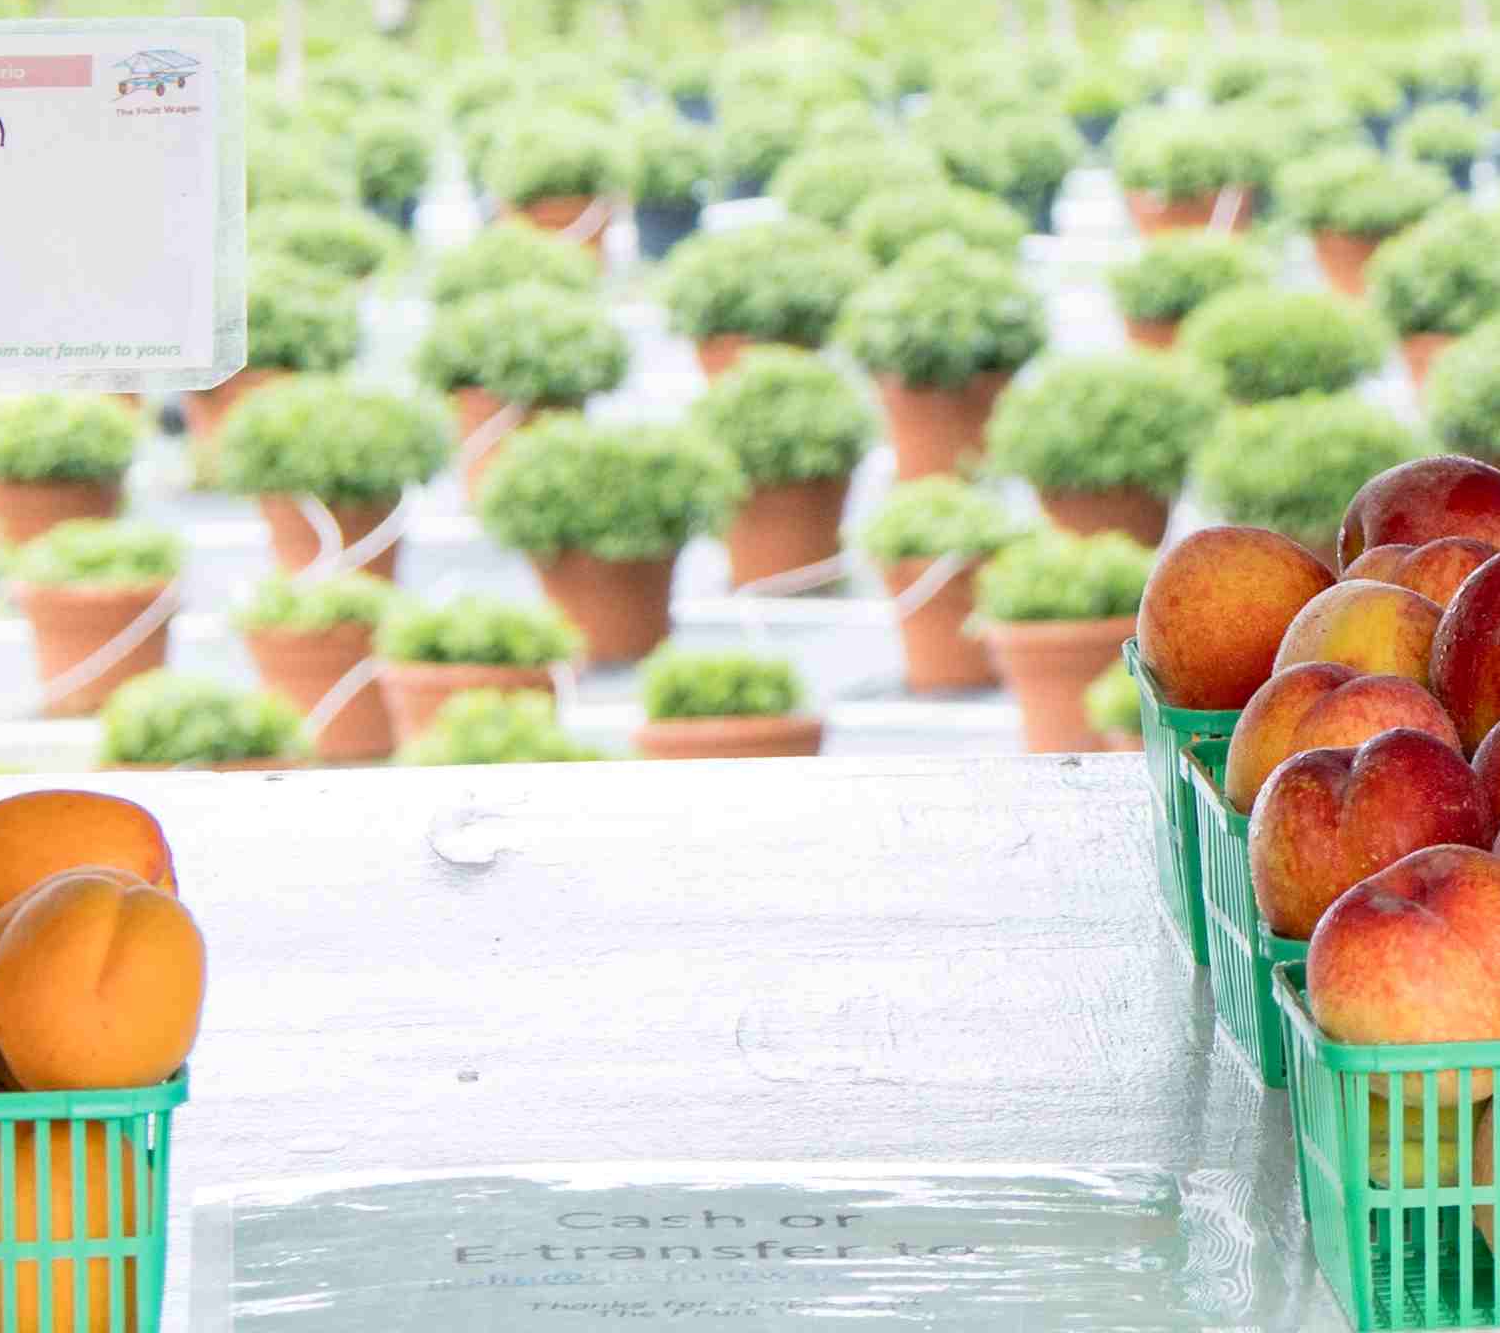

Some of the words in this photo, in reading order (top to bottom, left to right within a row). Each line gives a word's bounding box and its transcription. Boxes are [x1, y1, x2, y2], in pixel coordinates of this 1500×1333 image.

[56, 341, 110, 360] family
[114, 342, 132, 357] to
[136, 343, 182, 360] yours
[556, 1209, 747, 1230] Cash
[779, 1213, 865, 1229] or
[455, 1239, 862, 1264] E-transfer
